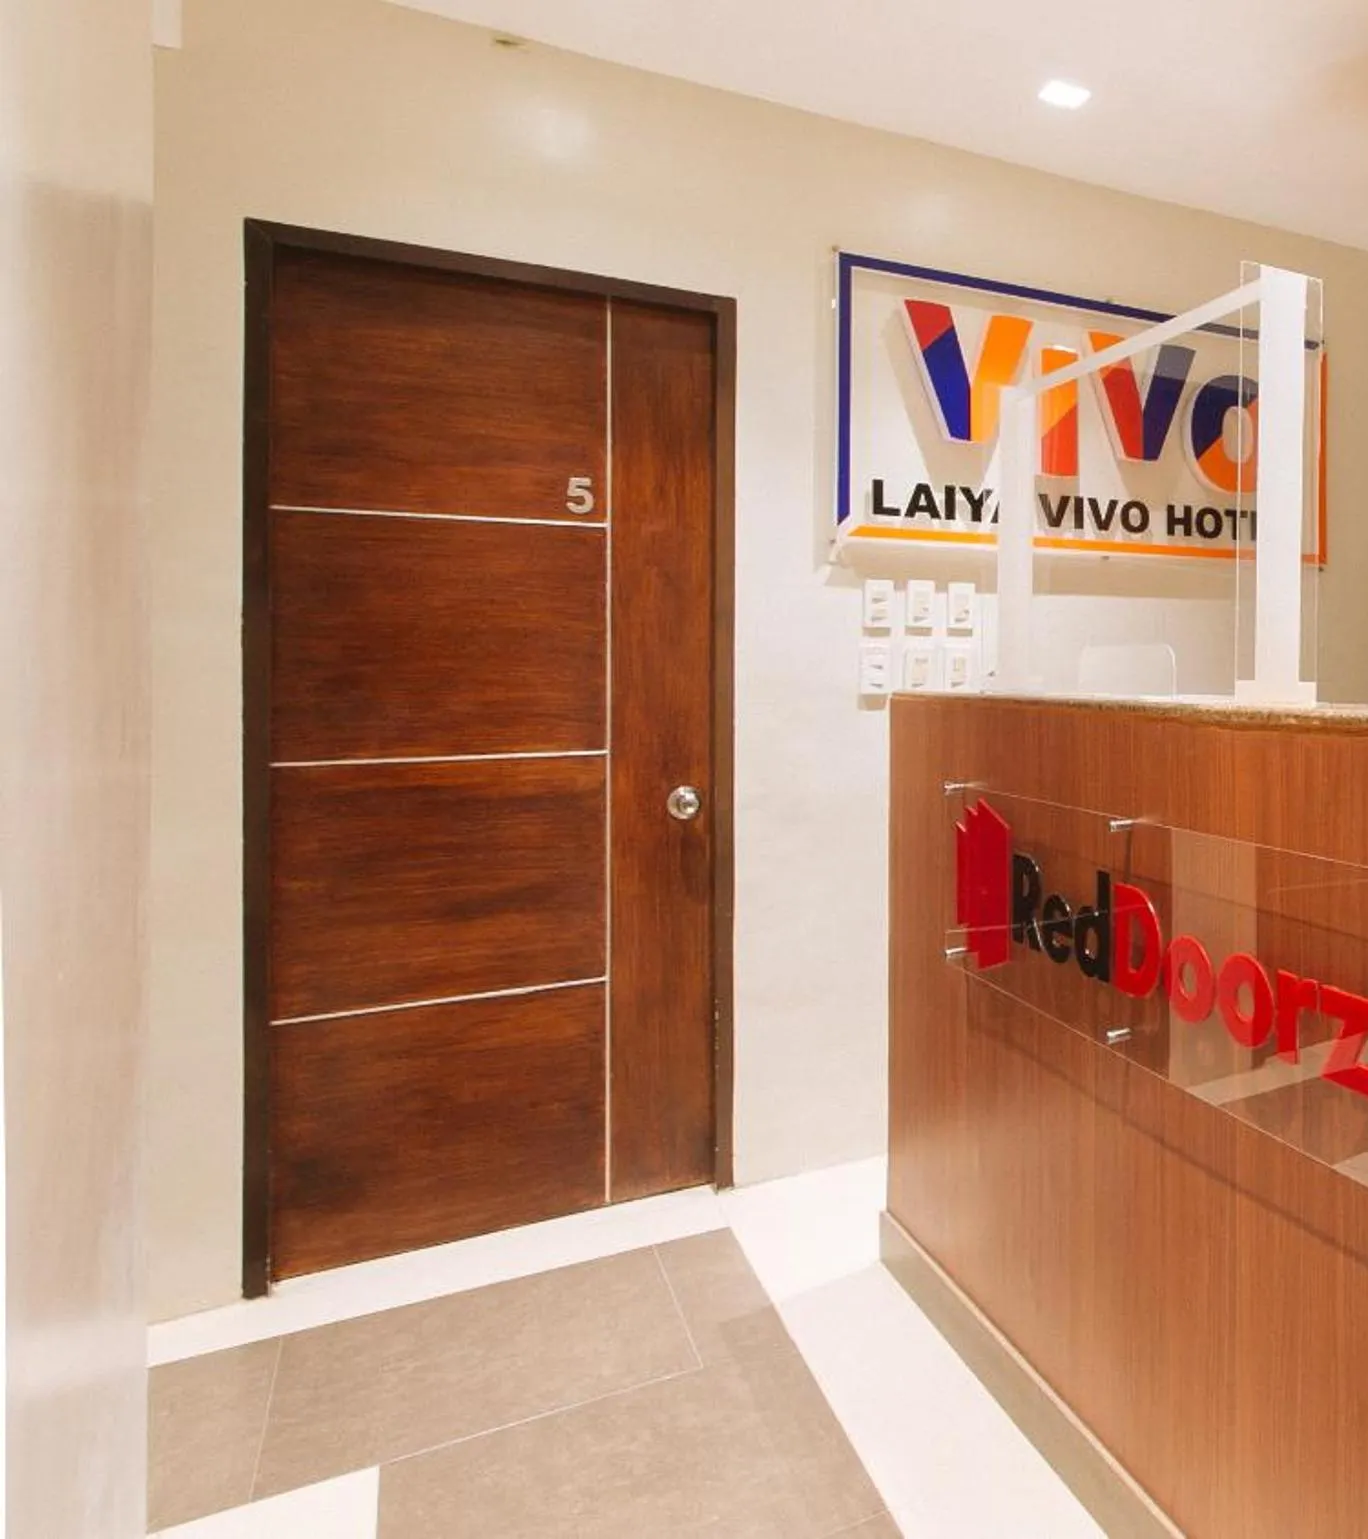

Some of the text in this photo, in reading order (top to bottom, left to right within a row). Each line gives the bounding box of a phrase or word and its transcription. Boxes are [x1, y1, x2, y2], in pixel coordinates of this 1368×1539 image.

[566, 477, 594, 514] 5
[1038, 493, 1150, 534] VIVO
[1166, 504, 1257, 541] HOT
